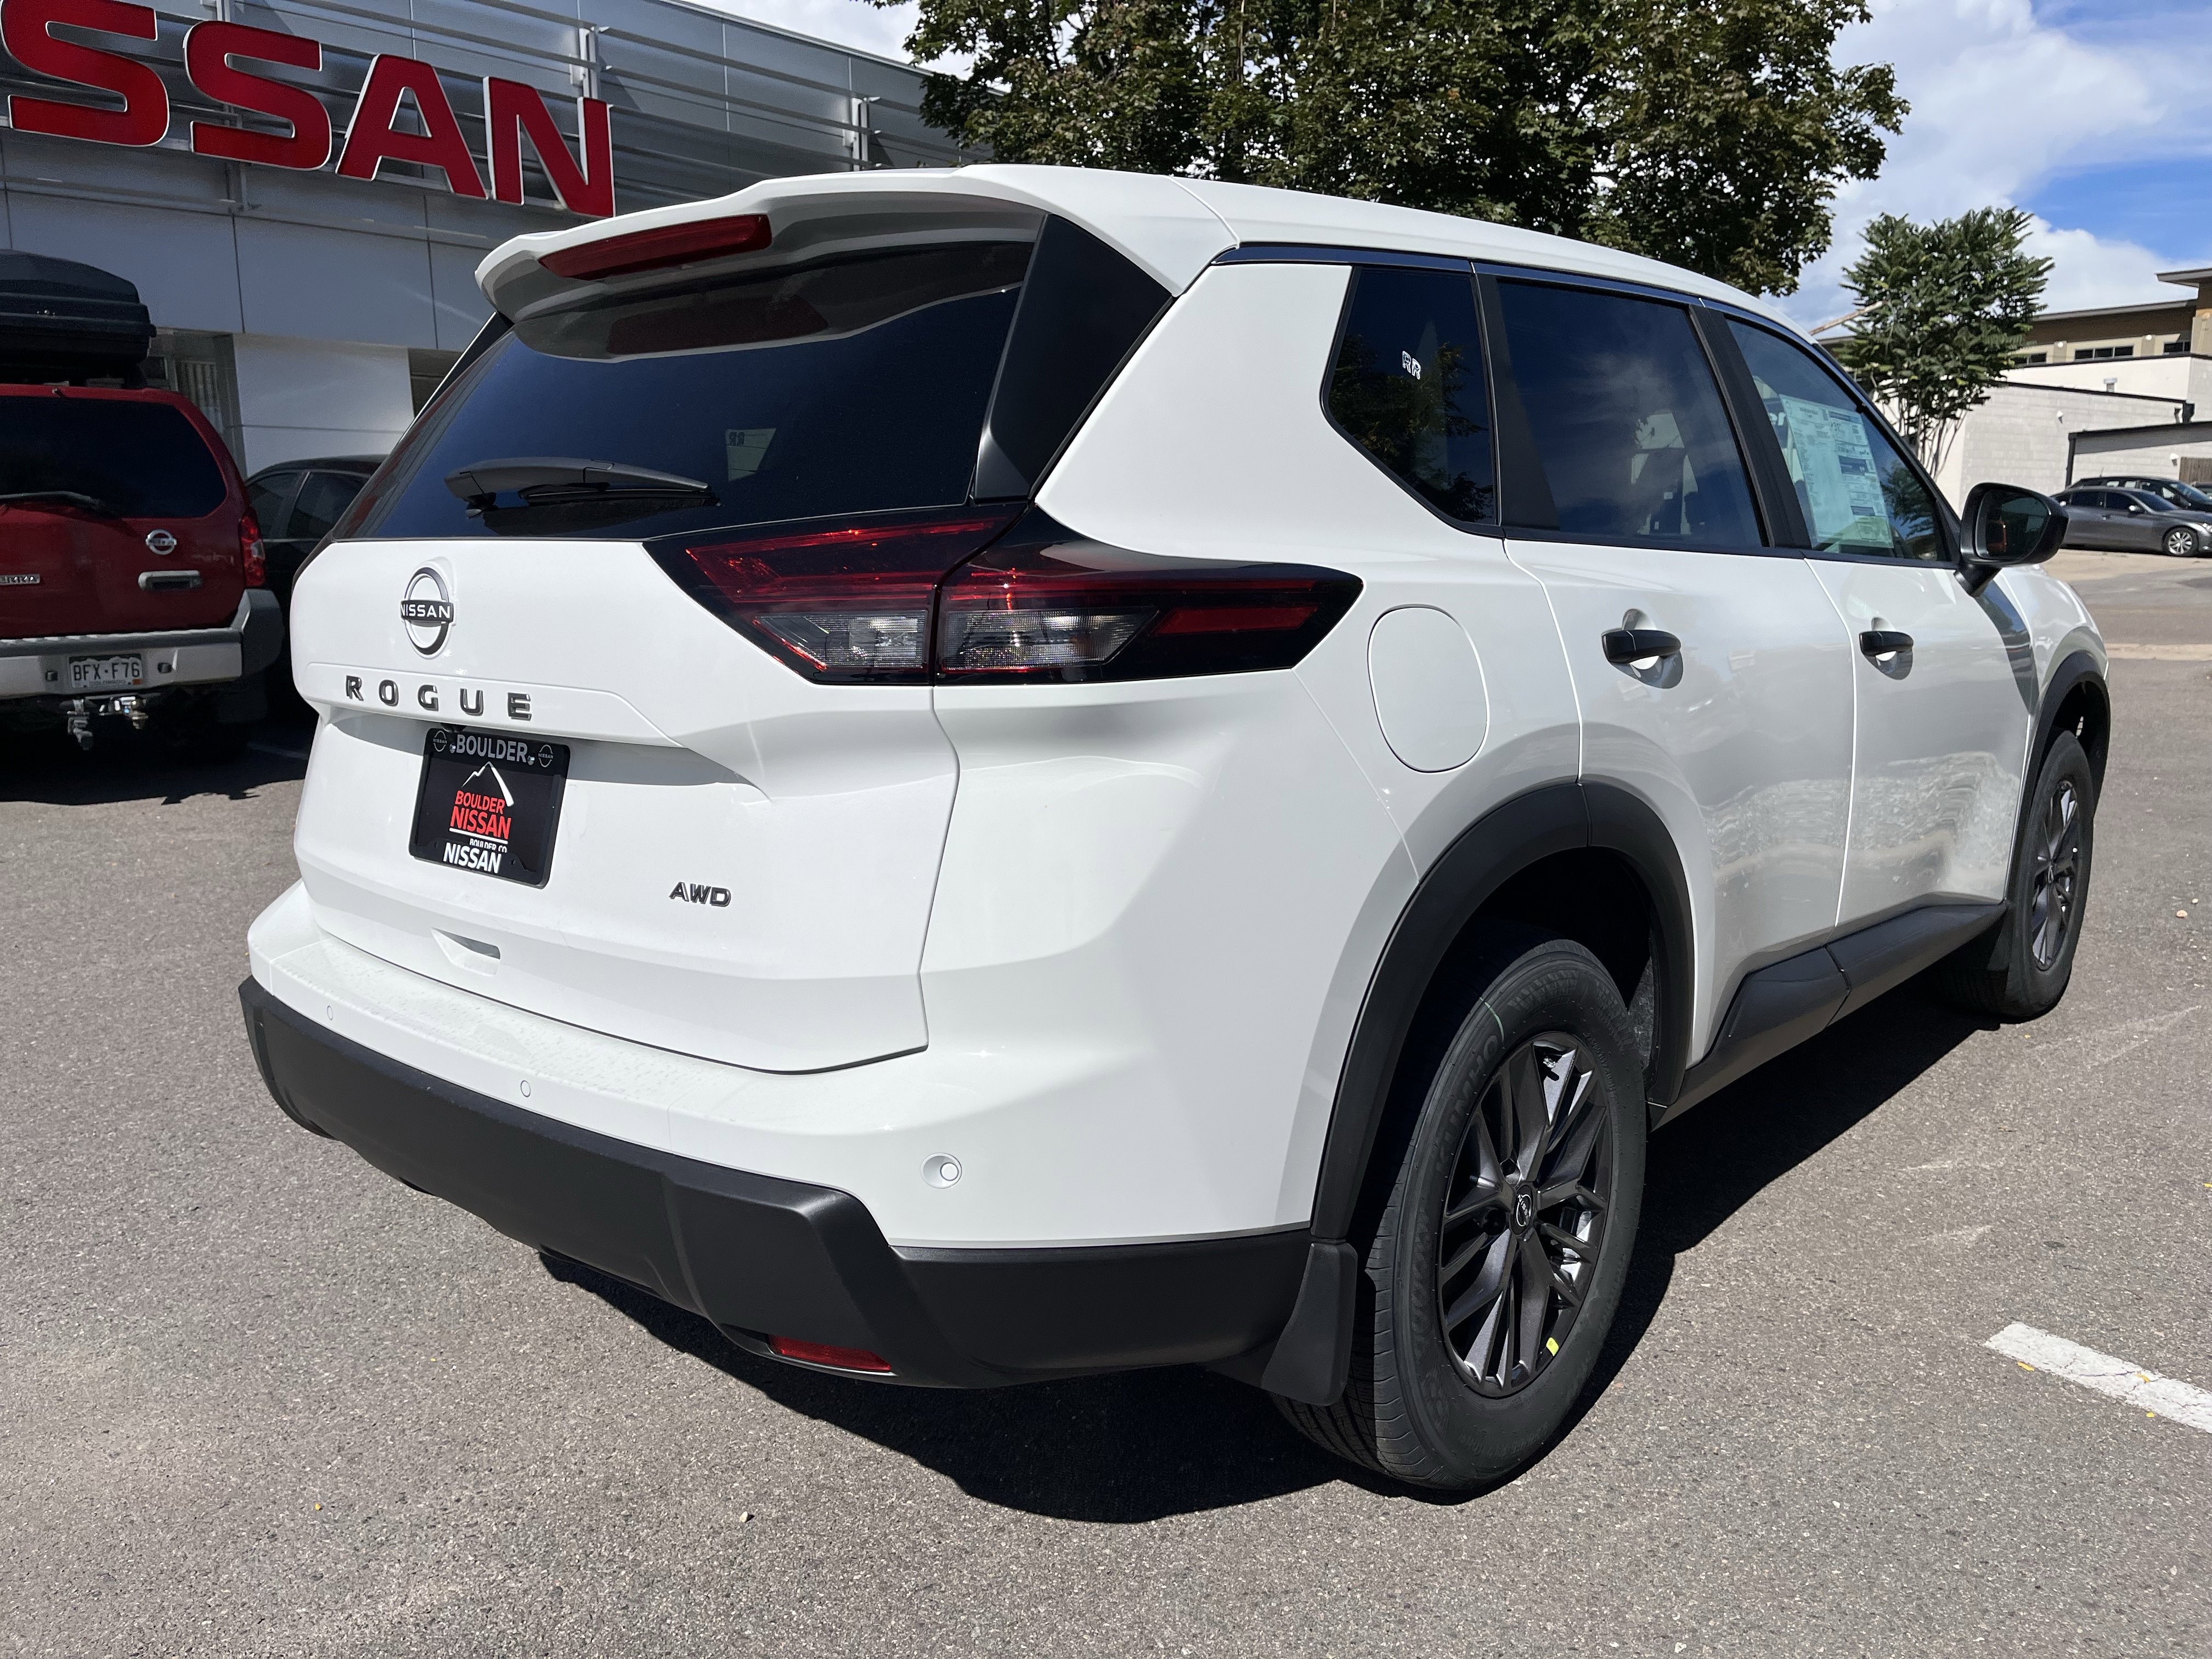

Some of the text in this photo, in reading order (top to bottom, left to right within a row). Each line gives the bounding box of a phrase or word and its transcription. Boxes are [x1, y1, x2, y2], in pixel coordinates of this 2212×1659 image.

[400, 603, 450, 618] NISSAN
[346, 675, 532, 721] ROGUE
[456, 734, 528, 763] BOULDER
[455, 790, 505, 814] BOULDER
[450, 806, 512, 840] NISSAN
[443, 842, 501, 874] NISSAN
[669, 882, 731, 907] AWD
